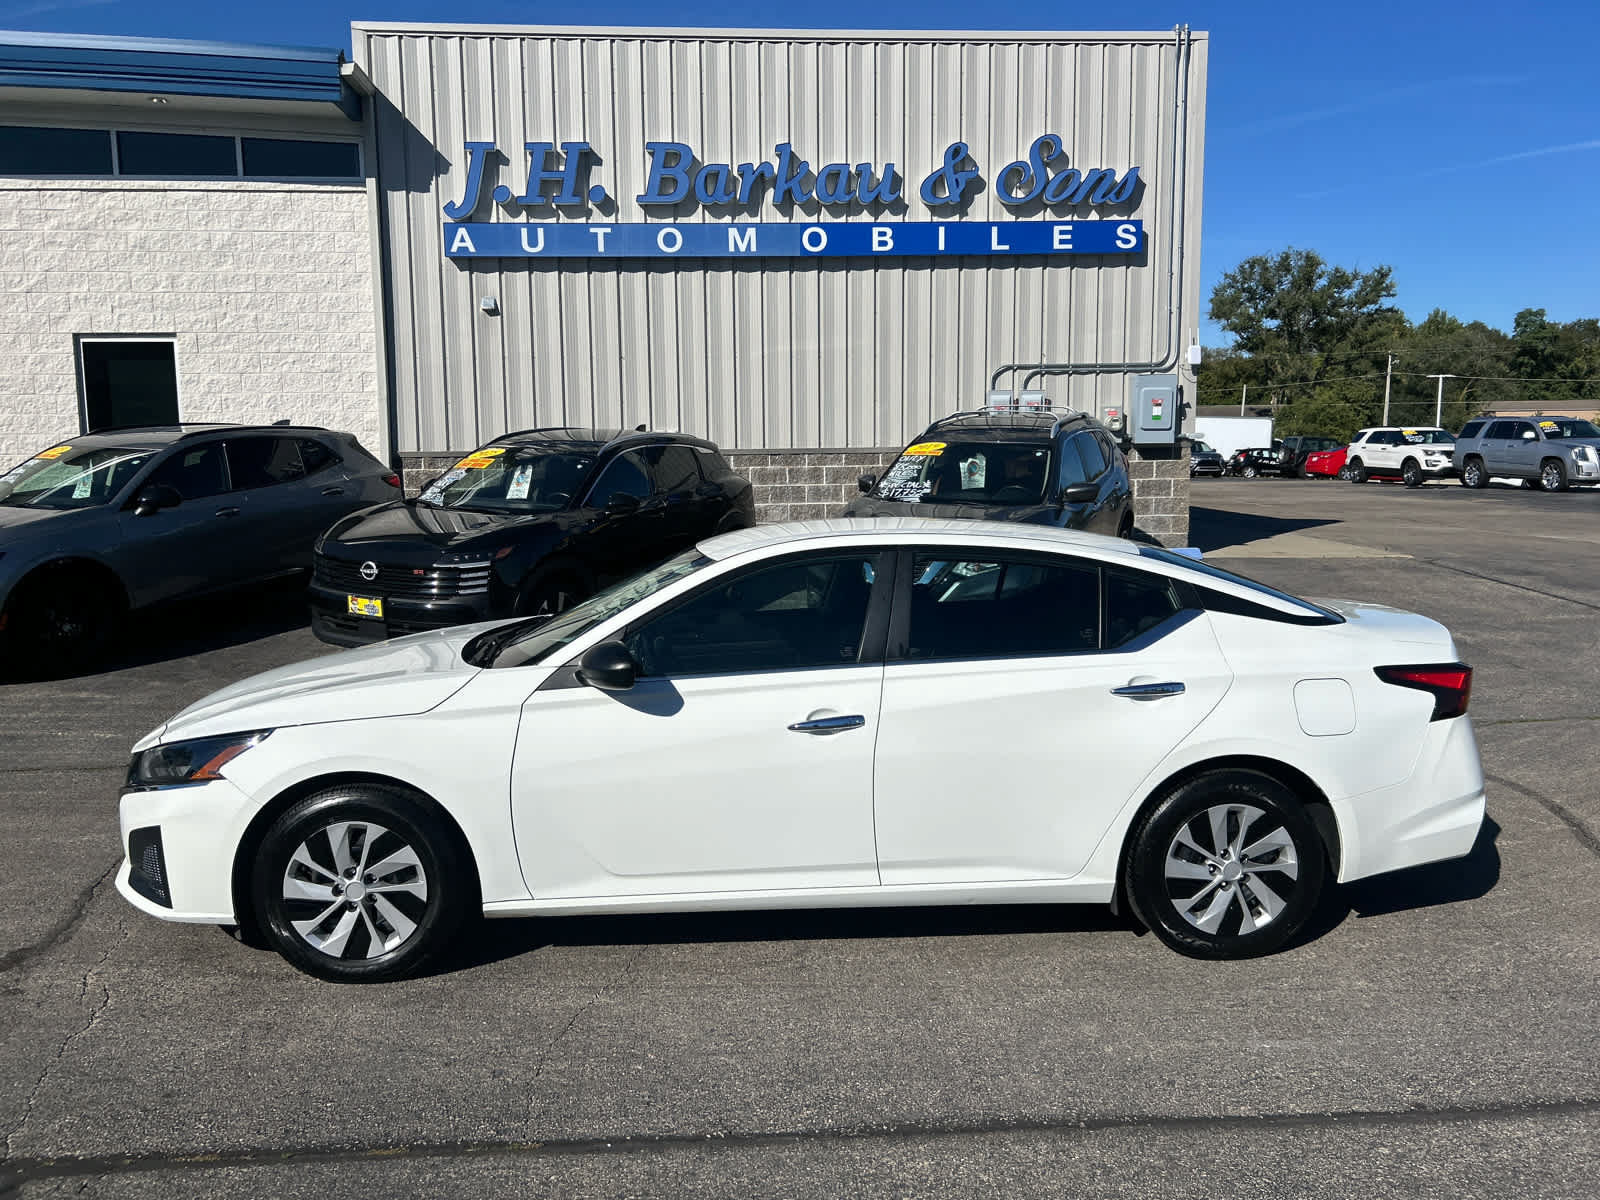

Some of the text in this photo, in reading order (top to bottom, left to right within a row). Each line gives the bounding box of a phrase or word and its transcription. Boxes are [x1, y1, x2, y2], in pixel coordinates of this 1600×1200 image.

[443, 133, 1141, 220] J.H. Barkau & Sons
[450, 224, 1138, 254] AUTOMOBILES
